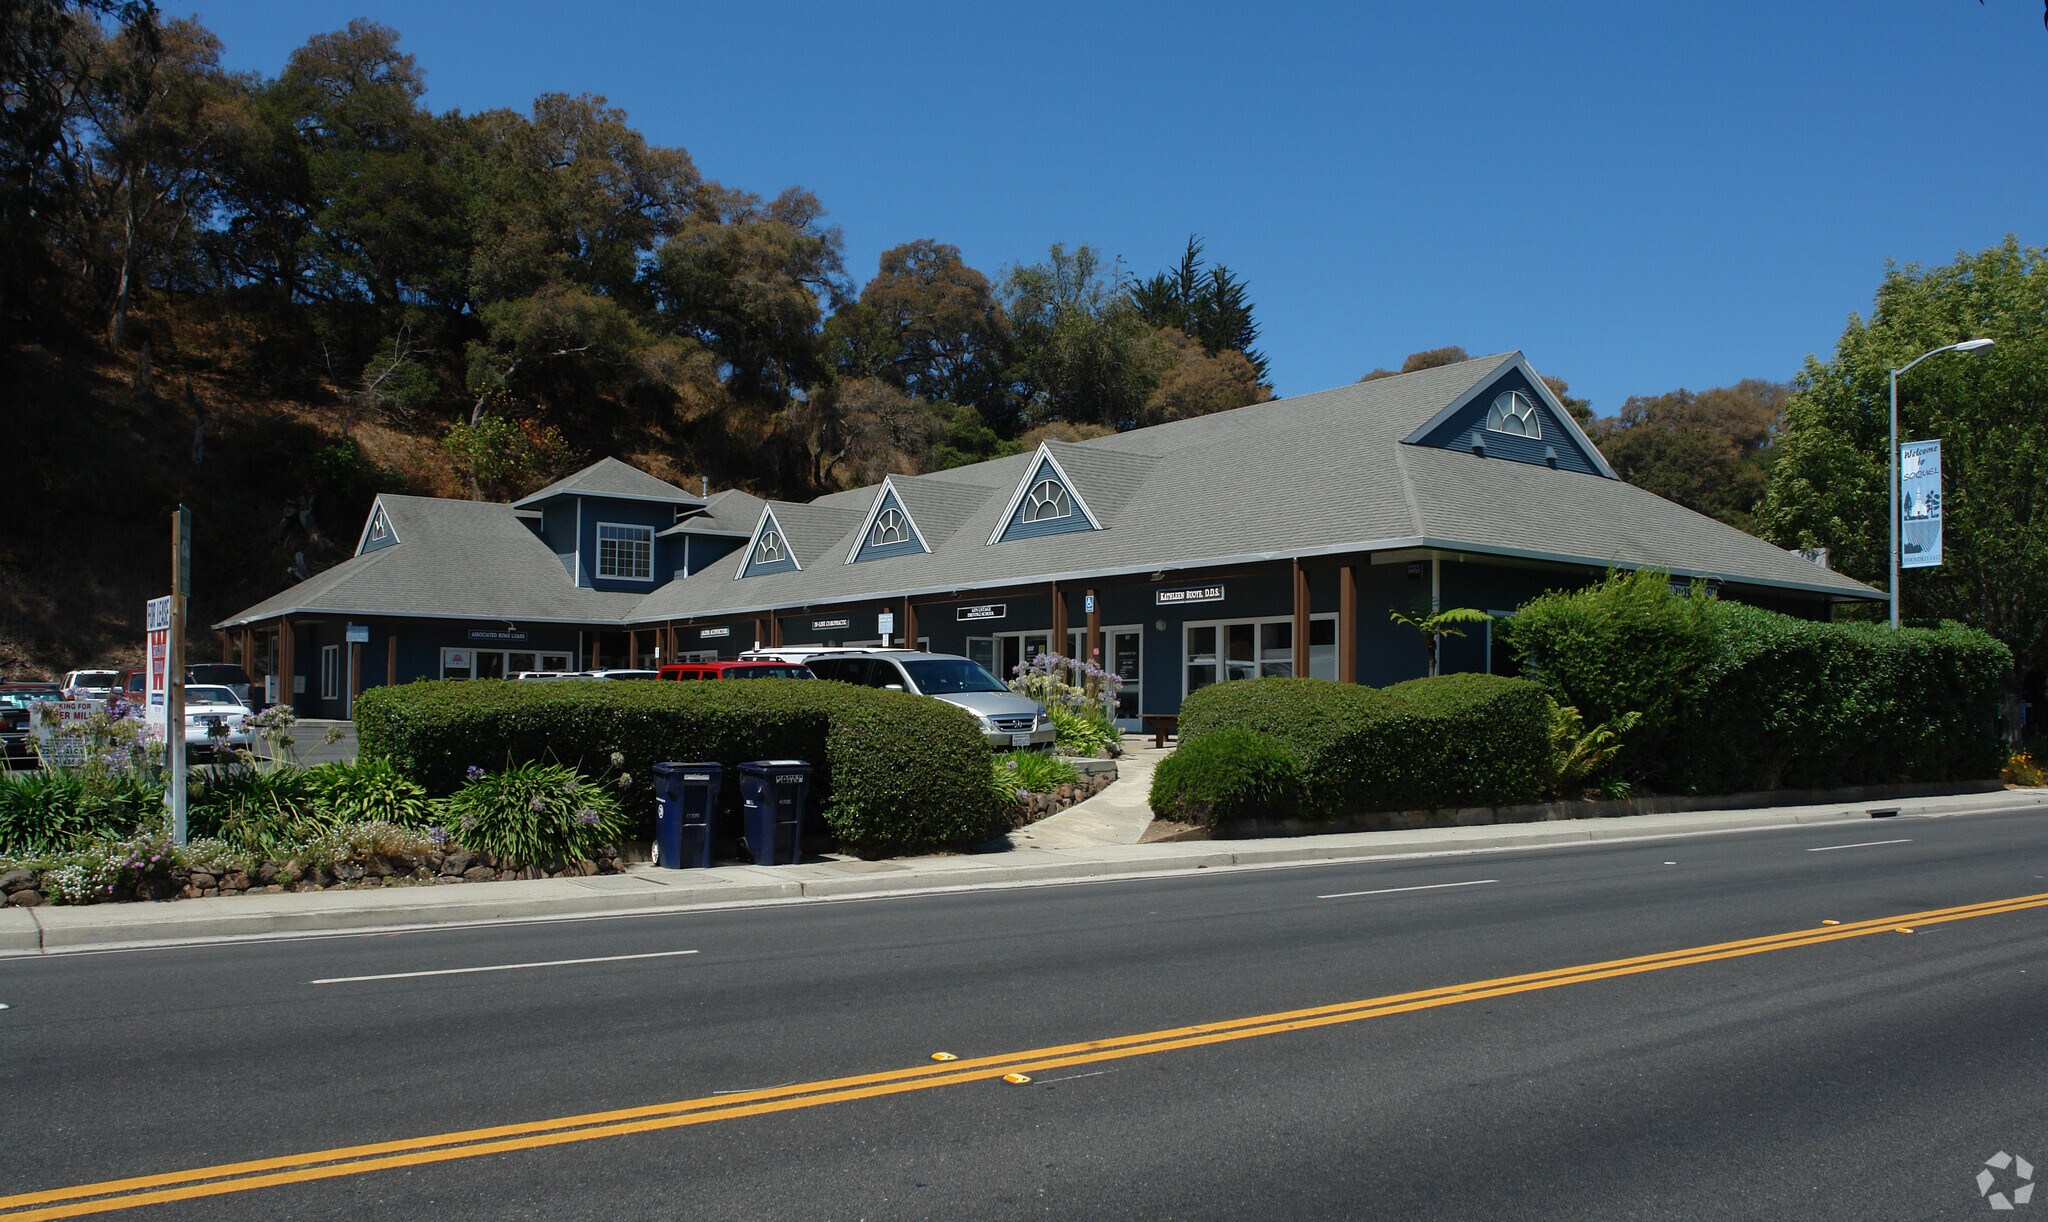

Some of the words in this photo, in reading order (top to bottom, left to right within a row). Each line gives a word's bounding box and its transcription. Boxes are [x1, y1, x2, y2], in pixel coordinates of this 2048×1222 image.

[1904, 446, 1938, 459] Welcome
[1917, 458, 1925, 466] to
[1903, 467, 1939, 482] SOQUEL
[1160, 592, 1185, 601] KATHLEEN
[148, 602, 156, 629] FOR
[156, 599, 169, 627] LEASE
